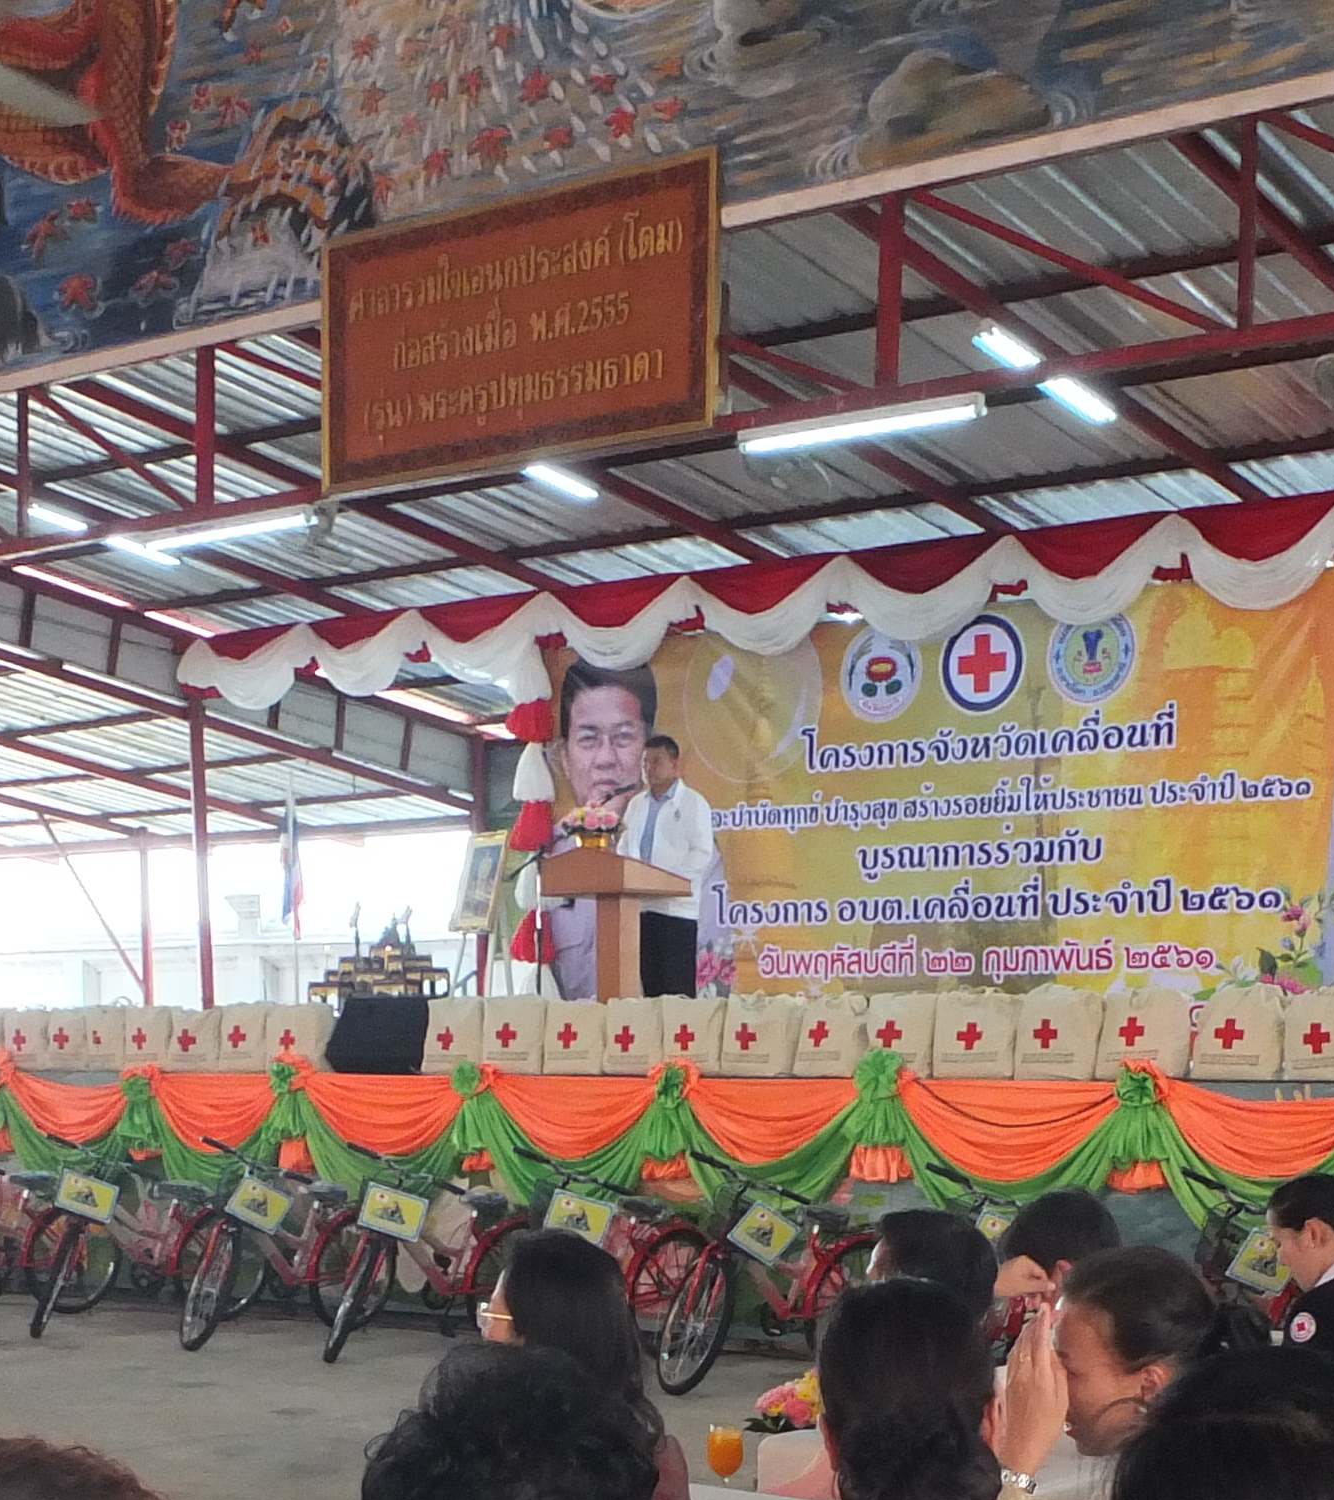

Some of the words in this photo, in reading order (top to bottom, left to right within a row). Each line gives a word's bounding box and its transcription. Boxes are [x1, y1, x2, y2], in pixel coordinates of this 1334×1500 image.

[619, 210, 683, 265] (โดม)
[394, 298, 516, 371] ก่อสร้างเมื่อ
[529, 291, 630, 342] พ.ศ.2555
[802, 703, 1177, 772] โครงการจังหวัดเคลื่อนที่
[825, 799, 898, 829] บำรุงสุข
[904, 777, 1143, 818] สร้างรอยยิ้มให้ประชาชน
[1150, 773, 1235, 803] ประจำปี
[1241, 777, 1313, 798] ๒๕๖๑
[858, 824, 1102, 880] บูรณาการร่วมกับ
[712, 884, 827, 925] โครงการ
[838, 876, 1041, 922] อบต.เคลื่อนที่
[1048, 878, 1172, 916] ประจำปี
[1180, 886, 1283, 911] ๒๕๖๑
[760, 936, 916, 979] วันพฤหัสบดีที่
[924, 951, 973, 973] ๒๒
[984, 939, 1114, 982] กุมภาพันธ์
[1124, 945, 1214, 970] ๒๕๖๑
